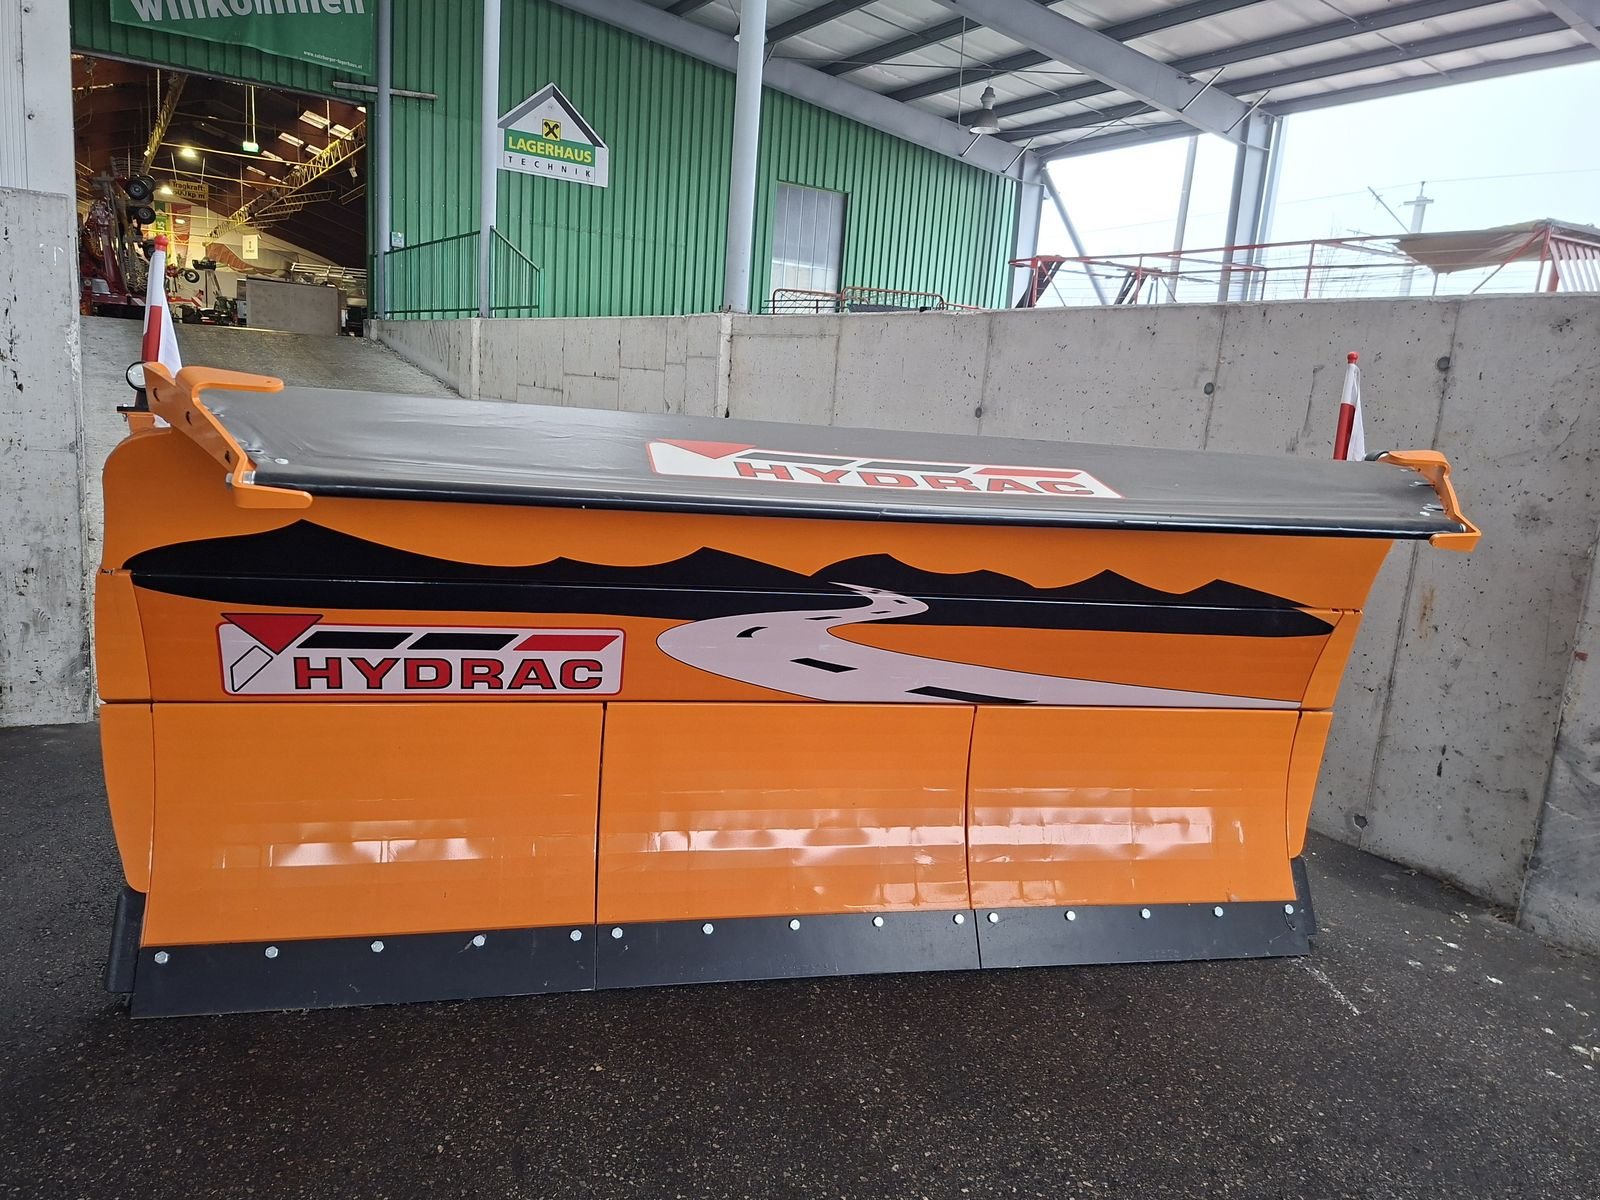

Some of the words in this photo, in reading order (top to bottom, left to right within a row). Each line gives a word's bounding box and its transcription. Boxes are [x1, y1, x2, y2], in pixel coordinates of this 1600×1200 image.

[508, 135, 592, 163] LAGERHAUS
[508, 155, 591, 178] TECHNIK
[733, 461, 1094, 495] HYDRAC
[293, 656, 603, 690] HYDRAC
